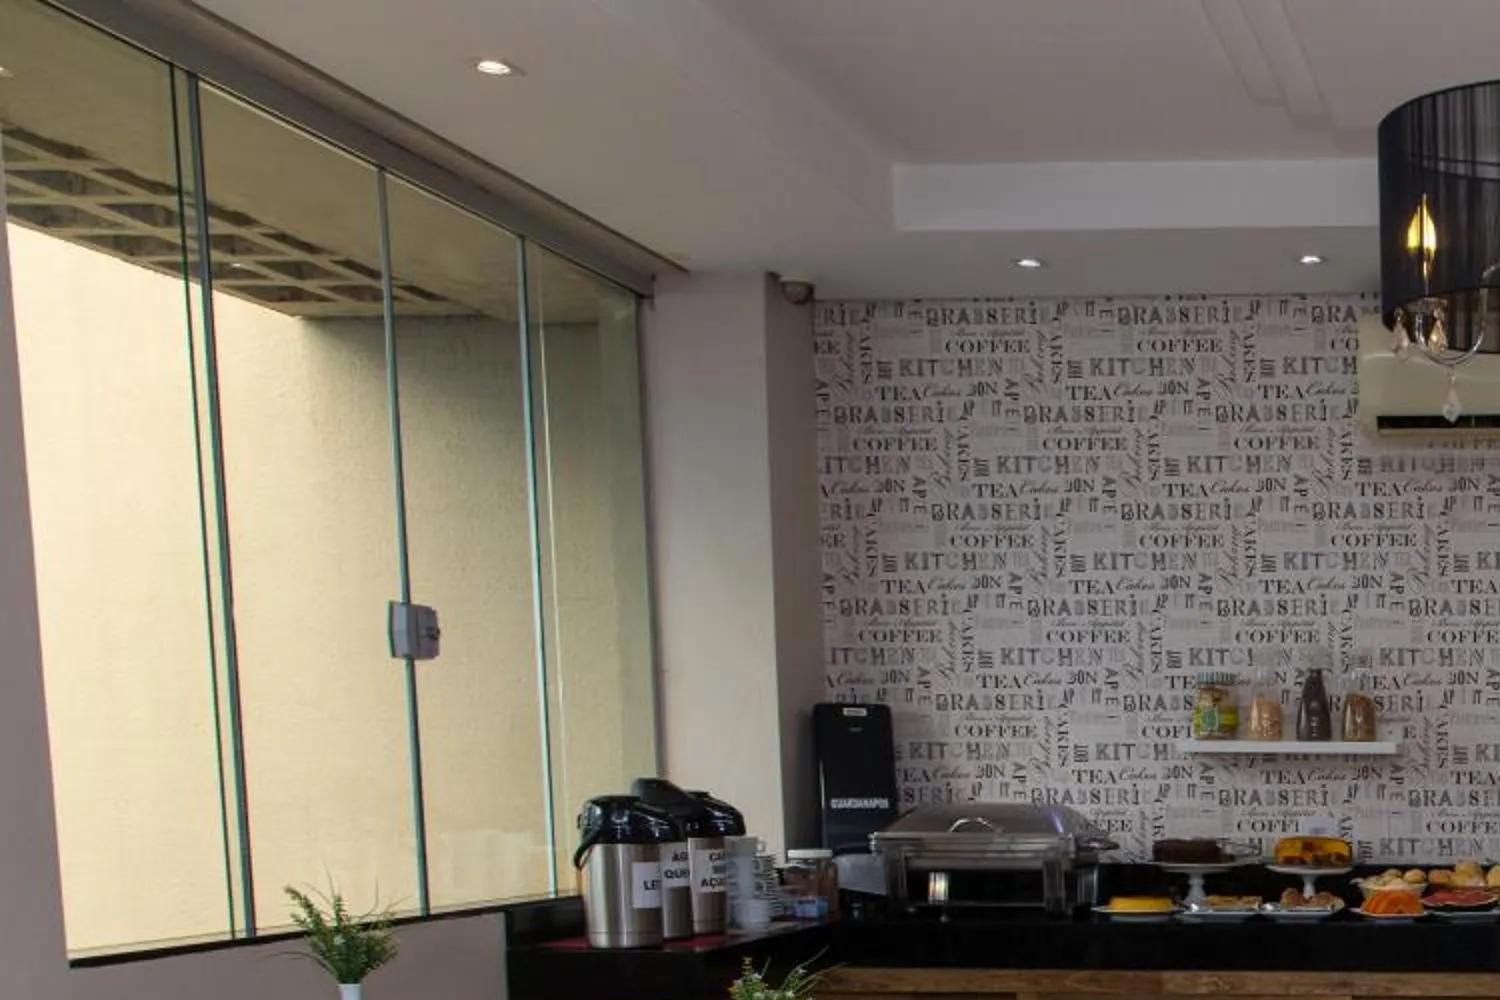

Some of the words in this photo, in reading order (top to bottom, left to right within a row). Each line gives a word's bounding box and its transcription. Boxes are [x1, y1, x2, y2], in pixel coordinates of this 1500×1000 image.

[945, 340, 1030, 354] COFFEE
[1136, 338, 1222, 353] COFFEE
[898, 358, 1003, 377] KITCHEN
[1089, 357, 1194, 376] KITCHEN
[874, 386, 921, 401] TEA
[1064, 385, 1111, 400] TEA
[1257, 384, 1304, 399] TEA
[853, 437, 937, 451] COFFEE
[1042, 437, 1127, 451] COFFEE
[1233, 436, 1319, 450] COFFEE
[822, 455, 910, 474] ITCHEN
[995, 455, 1100, 474] KITCHEN
[1186, 454, 1291, 473] KITCHEN
[971, 483, 1017, 497] TEA
[1161, 482, 1208, 497] TEA
[1354, 482, 1401, 497] TEA
[949, 534, 1033, 547] COFFEE
[1139, 533, 1224, 547] COFFEE
[1330, 533, 1416, 547] COFFEE
[903, 551, 1006, 570] KITCHEN
[1092, 551, 1196, 570] KITCHEN
[1283, 551, 1388, 570] KITCHEN
[879, 579, 925, 593] TEA
[1068, 579, 1114, 594] TEA
[1258, 579, 1305, 594] TEA
[1450, 579, 1497, 594] TEA
[858, 629, 941, 643] COFFEE
[1045, 629, 1130, 643] COFFEE
[1235, 630, 1320, 643] COFFEE
[827, 646, 915, 665] ITCHEN
[999, 647, 1102, 666] KITCHEN
[1379, 648, 1484, 666] KITCHEN
[975, 674, 1021, 689] TEA
[1354, 675, 1401, 690] TEA
[953, 724, 1037, 738] COFFEE
[1071, 769, 1116, 783] TEA
[1259, 770, 1305, 784] TEA
[1450, 770, 1496, 785] TEA
[1379, 837, 1484, 856] KITCHEN
